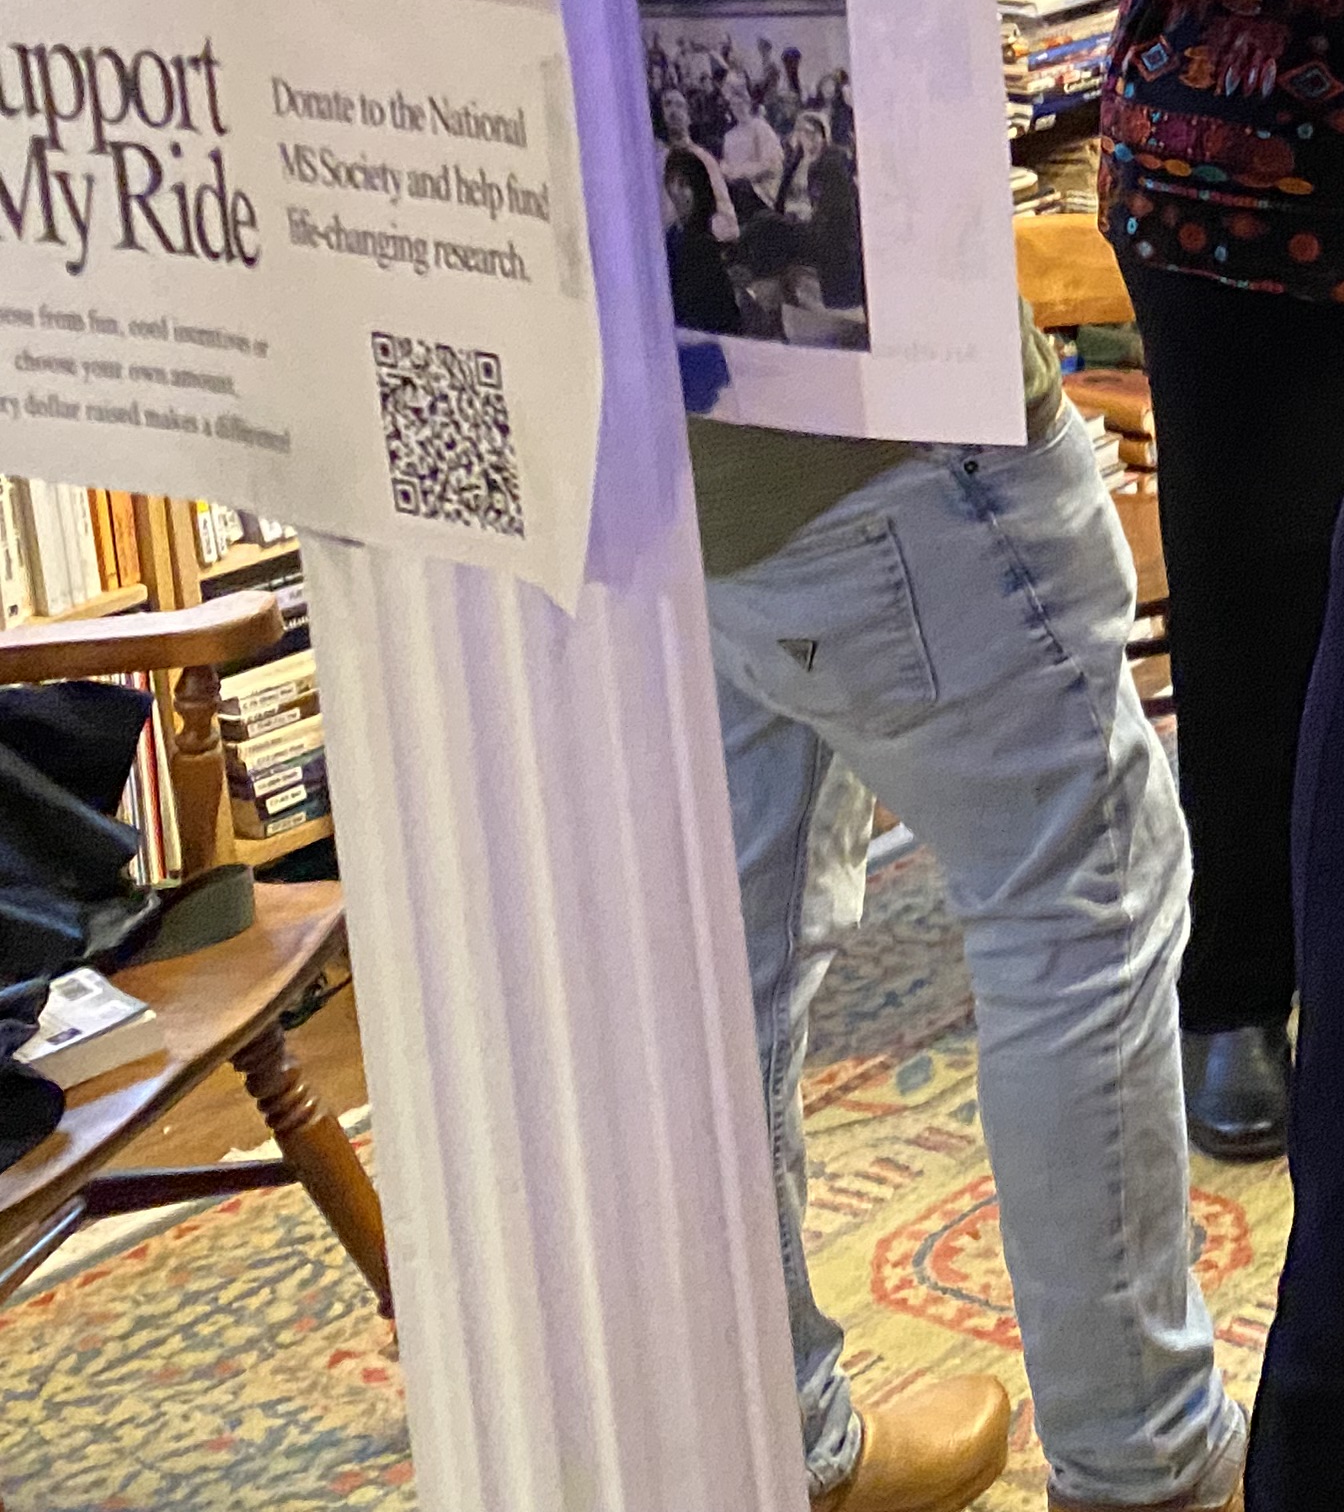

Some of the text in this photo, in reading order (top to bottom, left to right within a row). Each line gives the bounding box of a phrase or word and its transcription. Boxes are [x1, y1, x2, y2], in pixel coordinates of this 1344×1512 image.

[272, 74, 528, 149] Donate to the National
[107, 140, 262, 268] Ride
[278, 141, 550, 224] MS Society and help fund
[434, 240, 531, 283] research.
